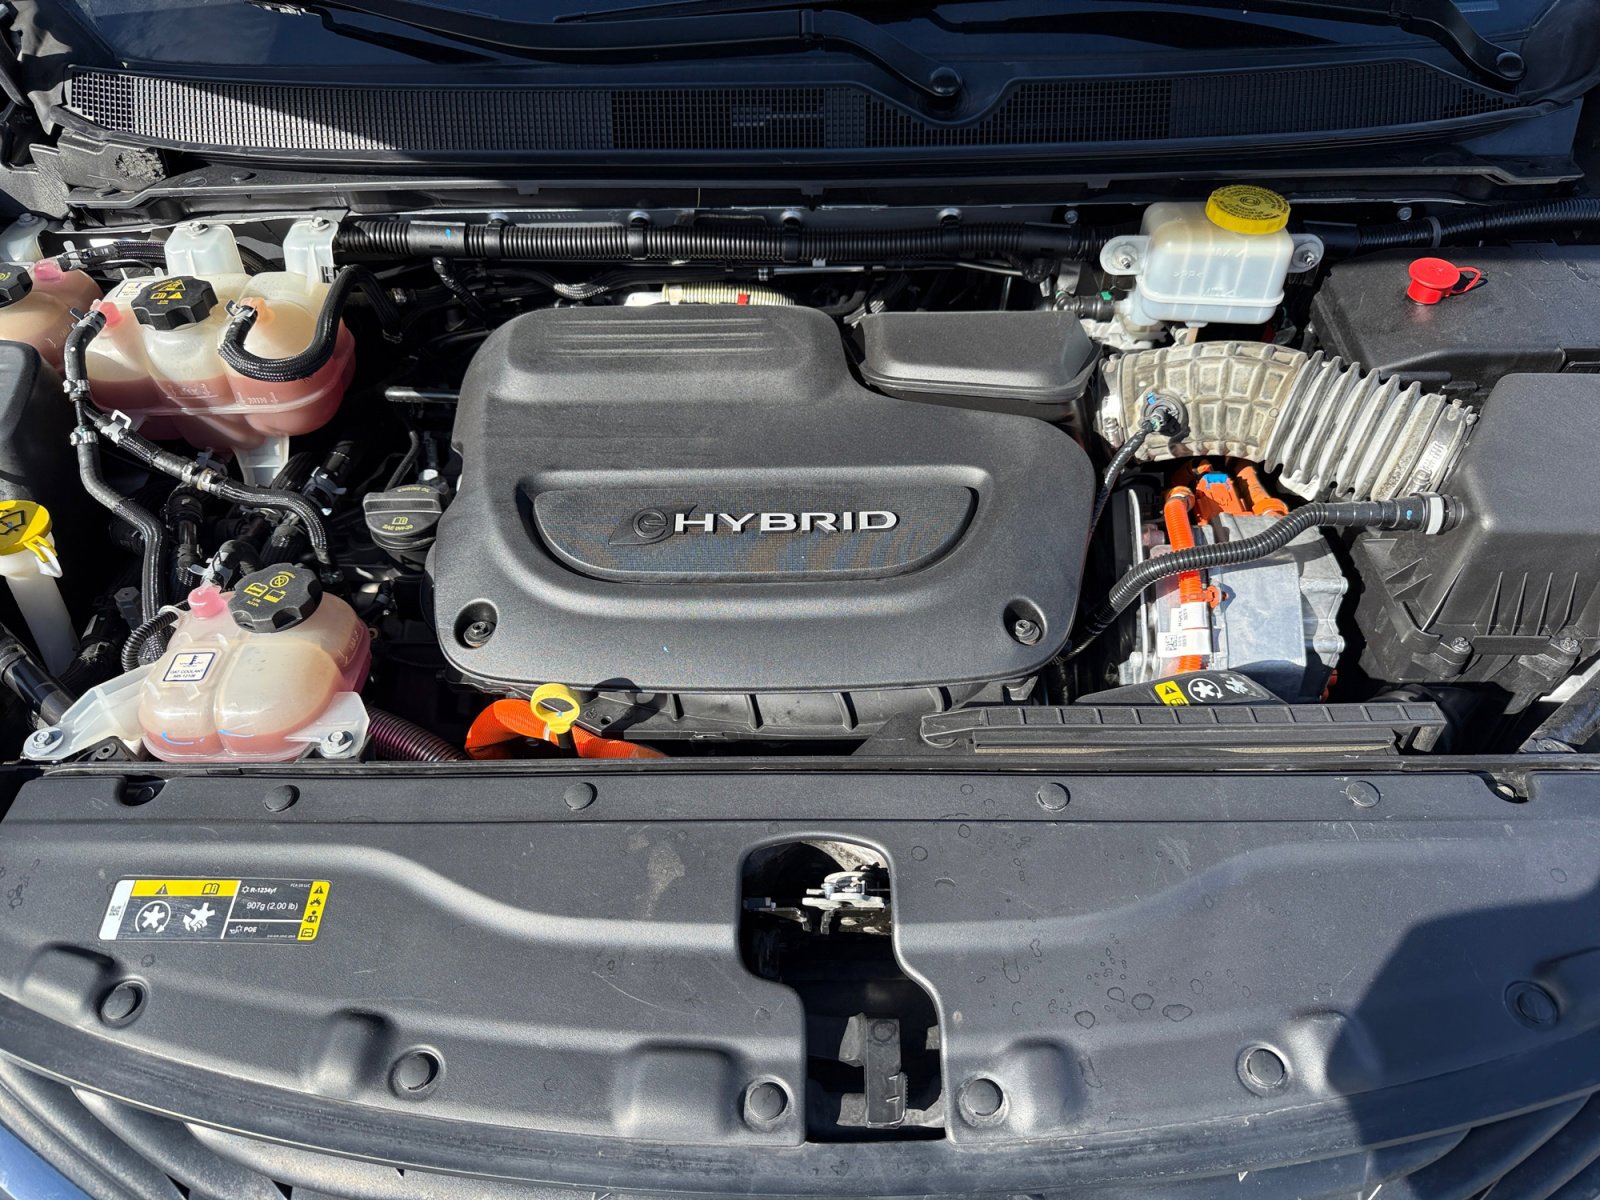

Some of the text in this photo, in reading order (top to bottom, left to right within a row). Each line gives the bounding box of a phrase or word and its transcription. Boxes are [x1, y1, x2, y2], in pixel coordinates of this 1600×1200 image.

[674, 510, 900, 534] HYBRID
[249, 887, 277, 895] R-1234yf
[246, 901, 299, 911] 907g (2.00 lb)
